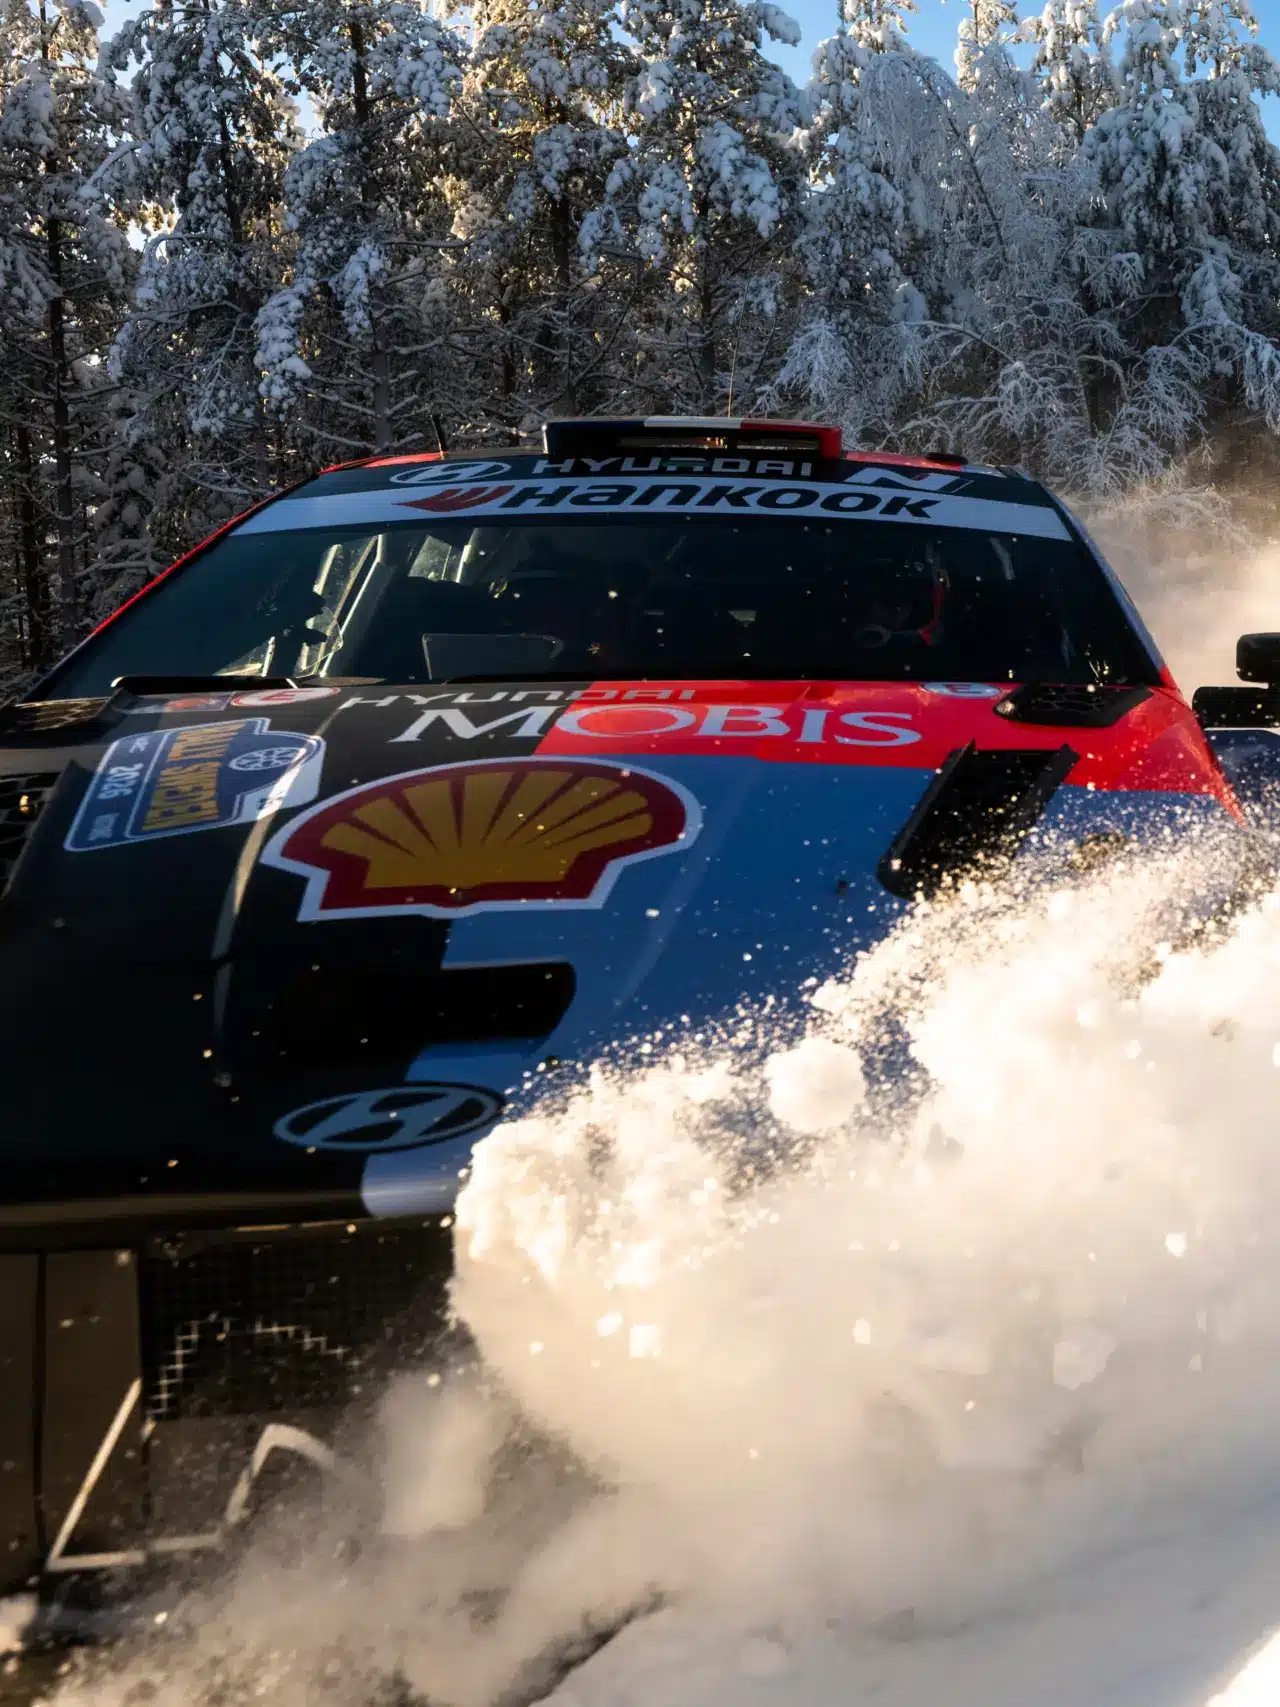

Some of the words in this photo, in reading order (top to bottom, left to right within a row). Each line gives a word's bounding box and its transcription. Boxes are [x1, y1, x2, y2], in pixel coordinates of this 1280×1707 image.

[531, 456, 813, 477] HYUNDAI
[338, 689, 695, 710] HYUNDAI
[387, 703, 923, 747] MOBIS
[98, 763, 144, 800] 2026
[141, 761, 222, 831] SWEDEN
